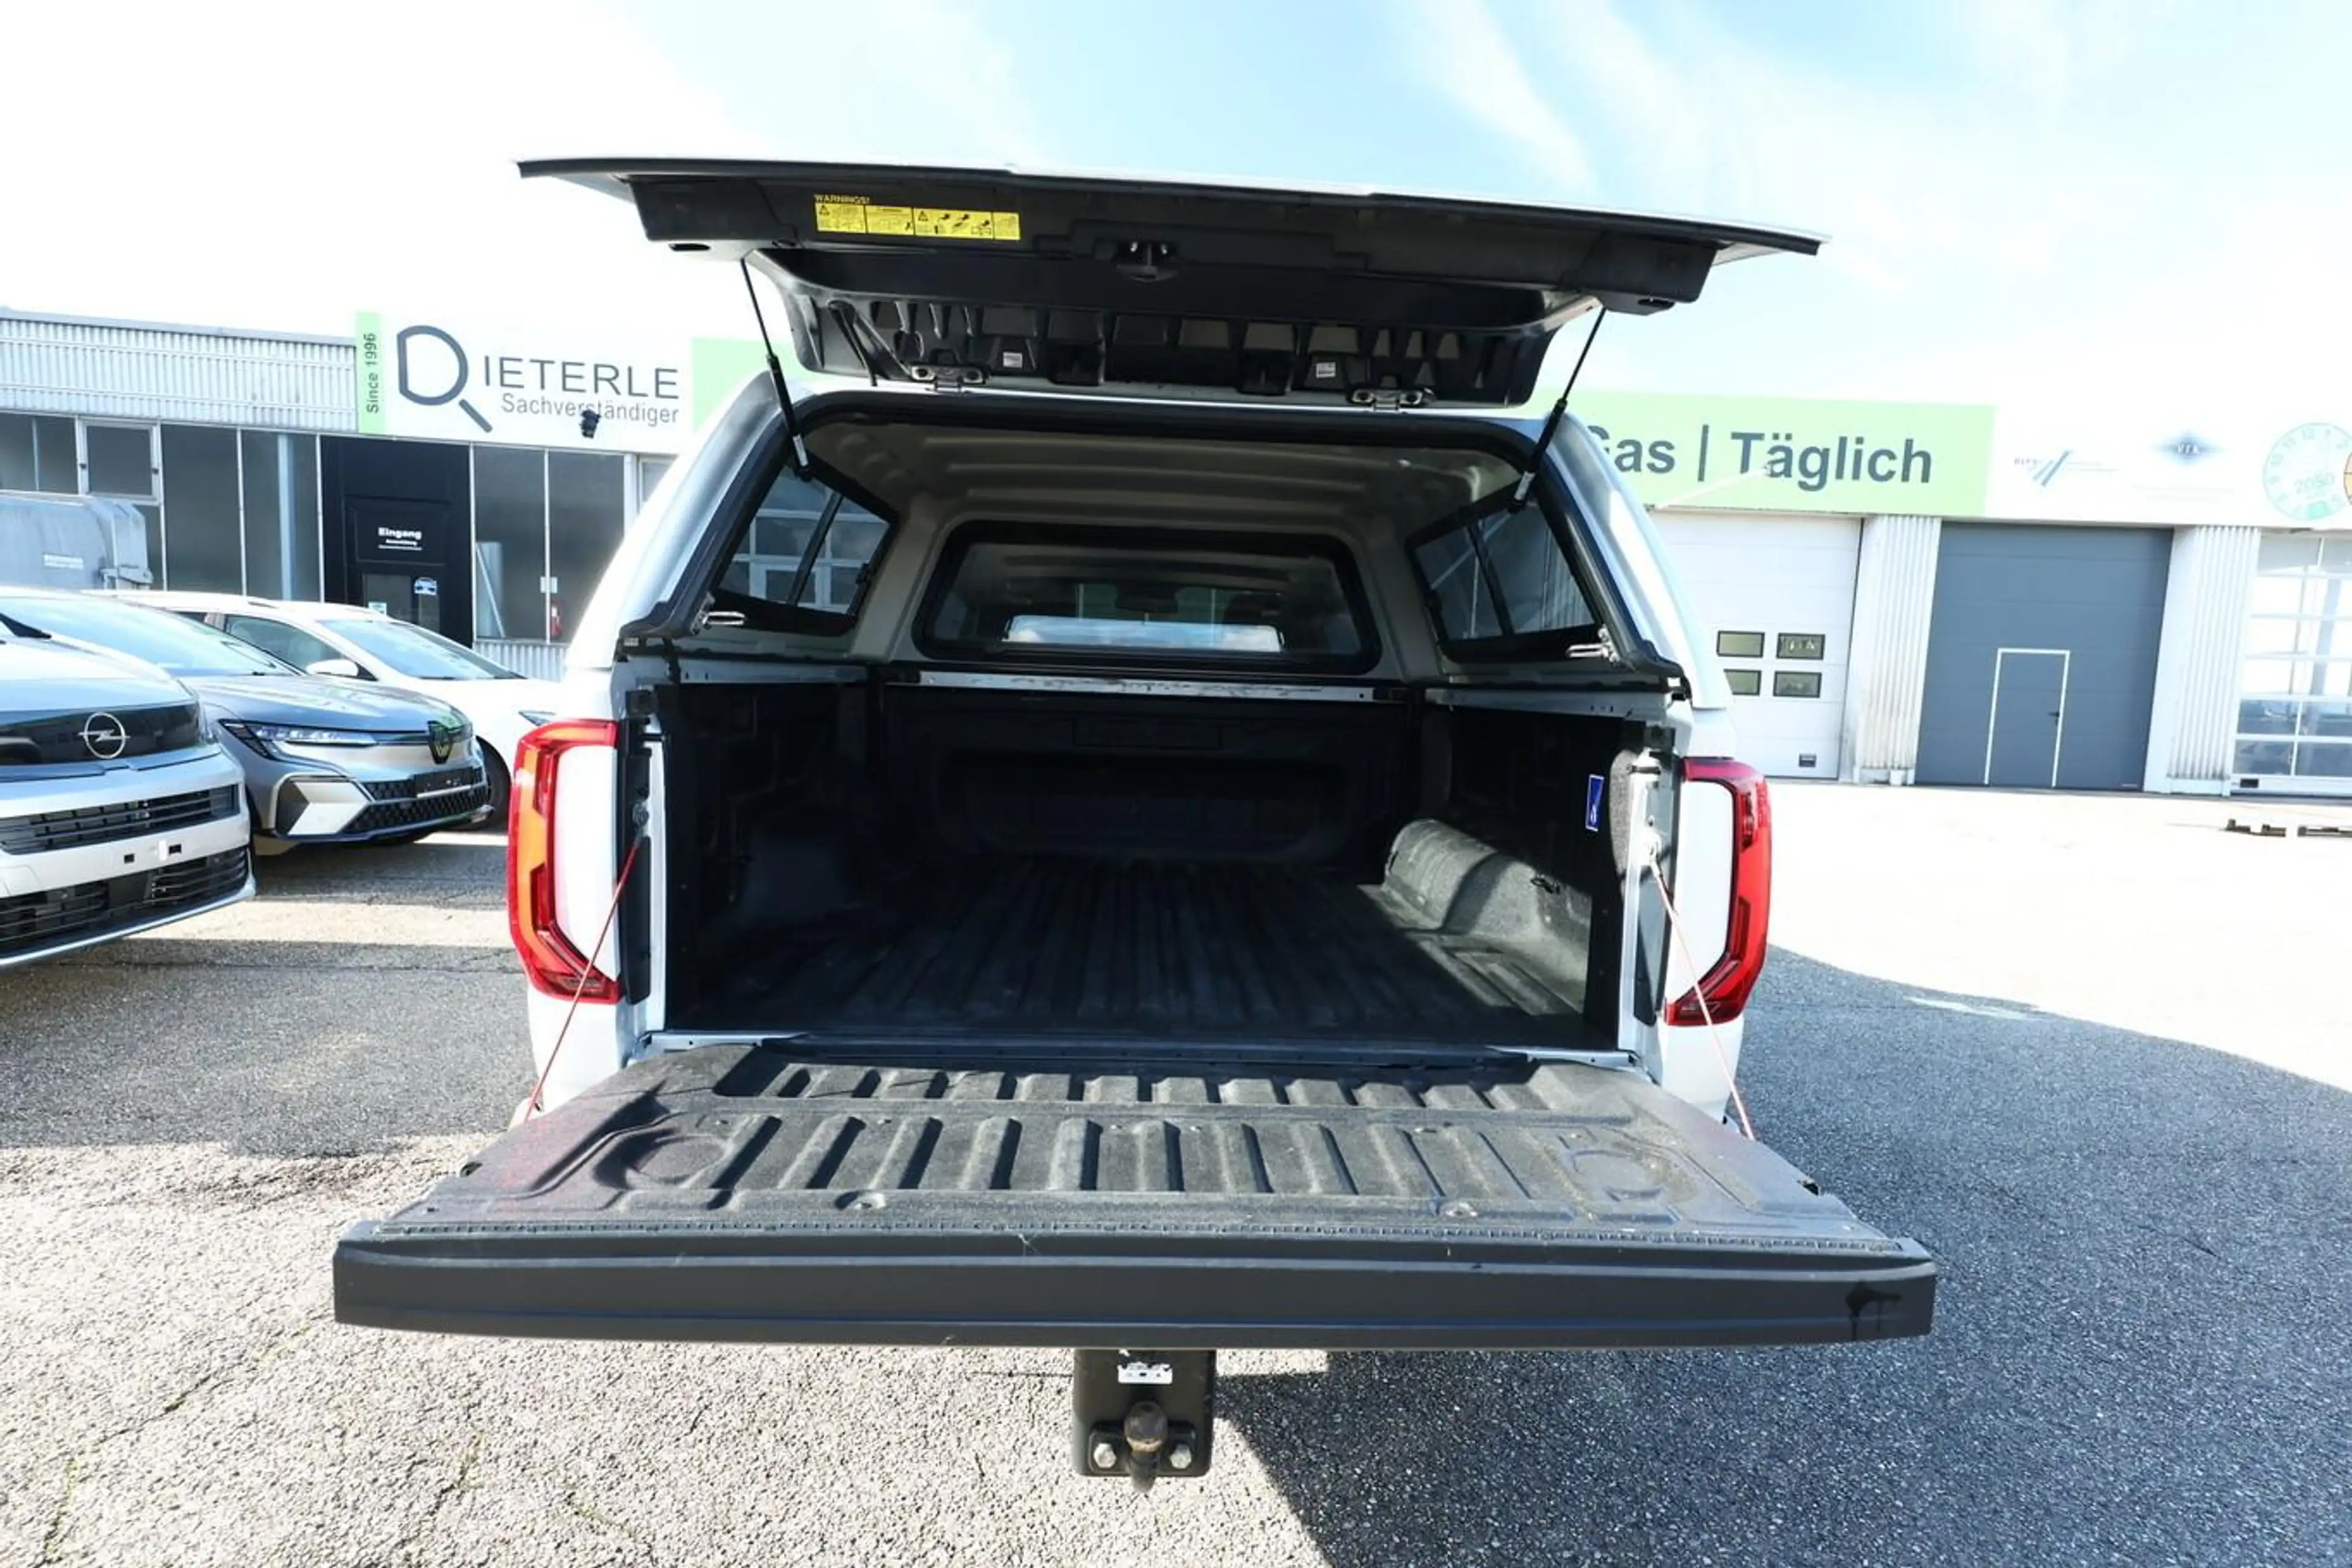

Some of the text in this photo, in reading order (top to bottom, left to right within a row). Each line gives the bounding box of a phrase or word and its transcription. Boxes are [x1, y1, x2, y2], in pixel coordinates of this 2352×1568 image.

[363, 333, 379, 414] Since 1996
[1730, 431, 1932, 492] Täglich
[378, 527, 423, 541] Eingang
